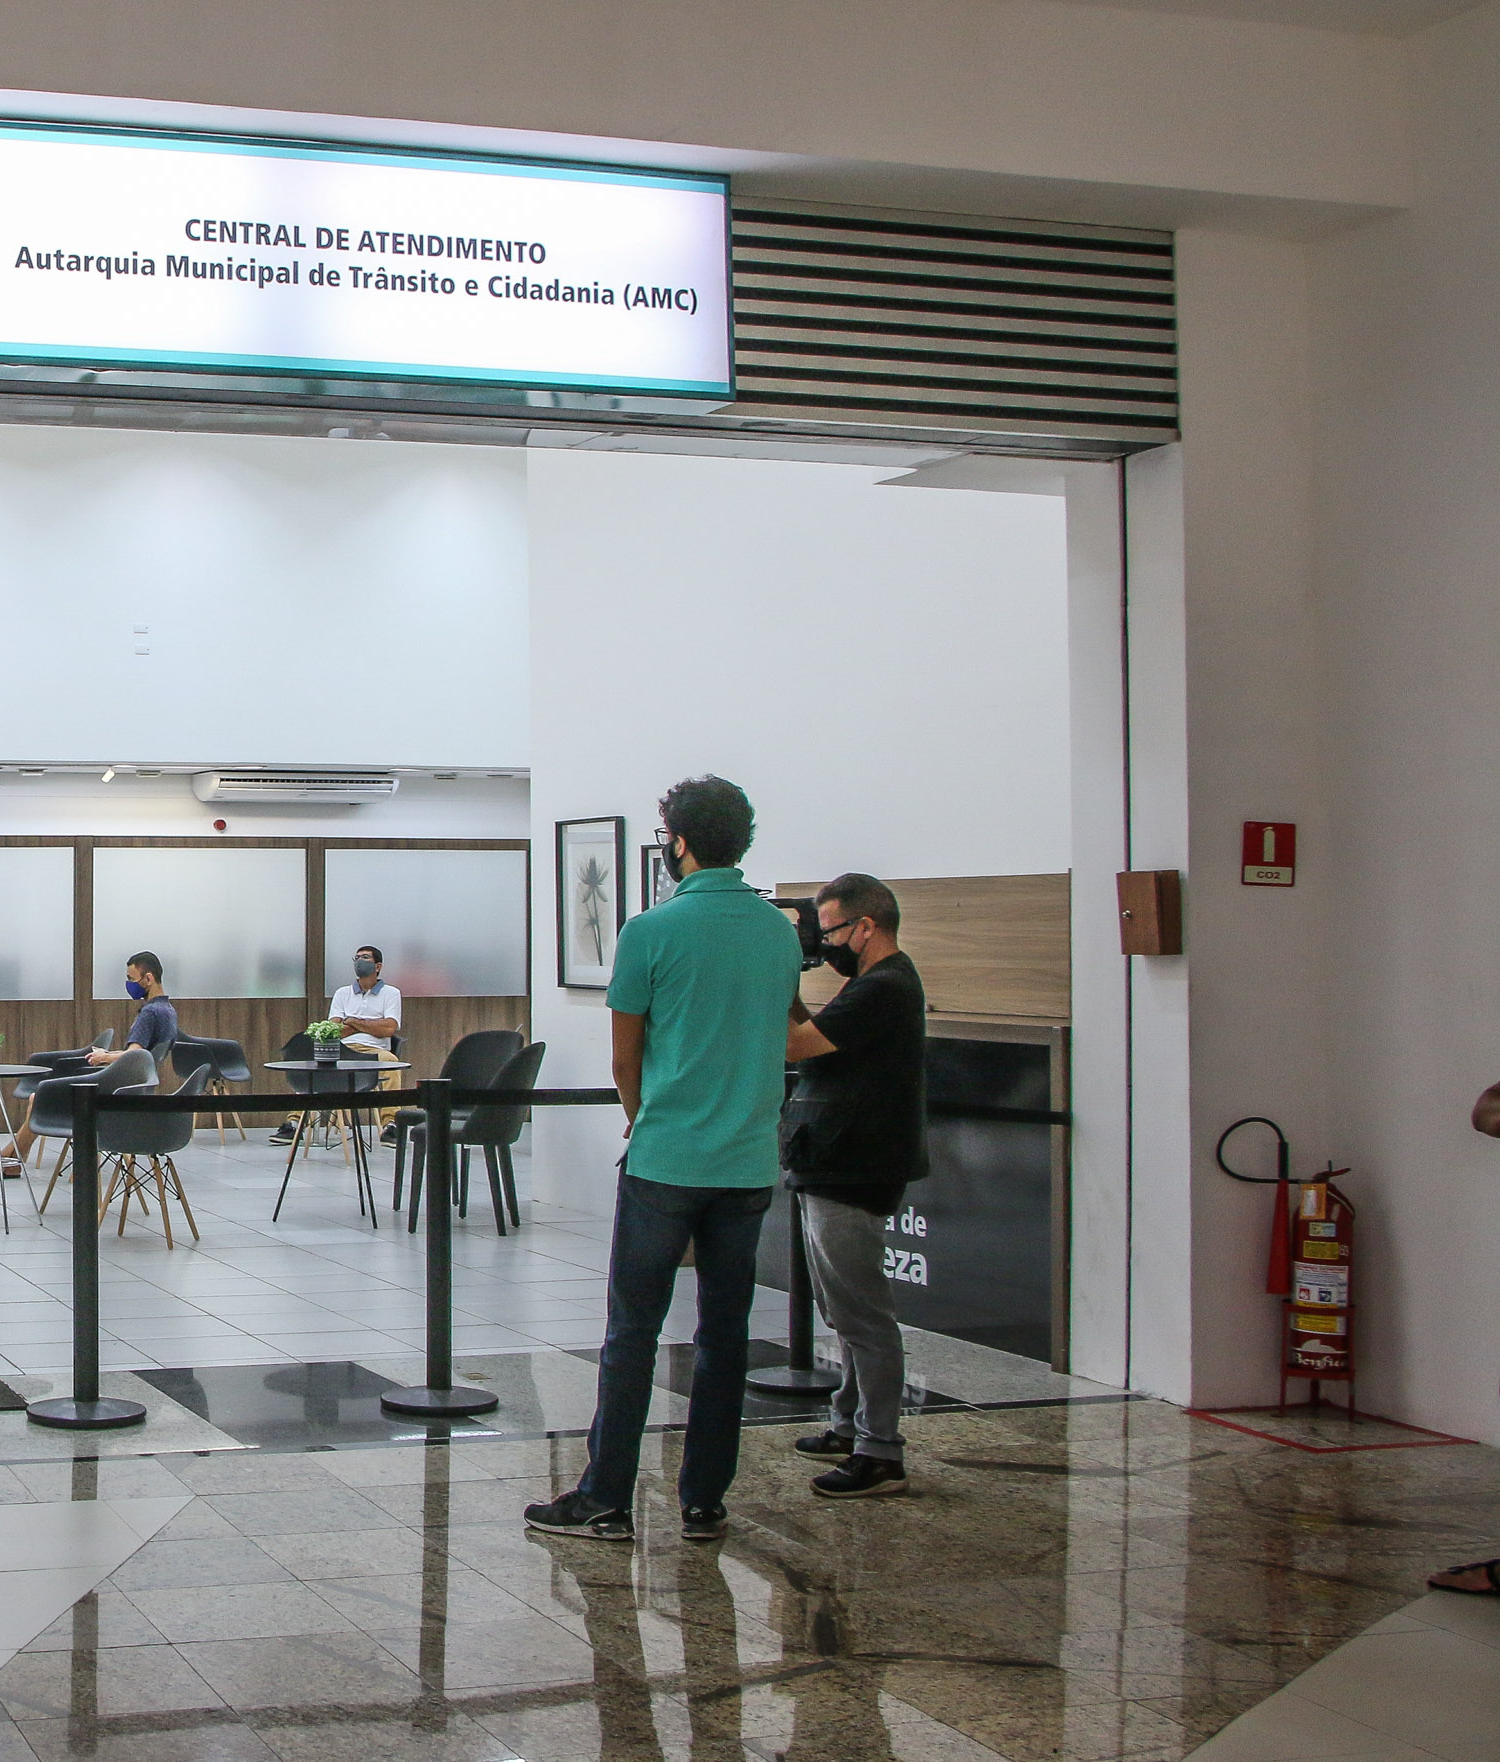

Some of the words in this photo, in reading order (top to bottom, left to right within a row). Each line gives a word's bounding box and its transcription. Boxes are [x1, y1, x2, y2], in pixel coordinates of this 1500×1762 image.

[185, 218, 307, 248] CENTRAL
[316, 226, 350, 251] DE
[357, 230, 546, 265] ATENDIMENTO
[14, 246, 156, 280] Autarquia
[166, 254, 299, 289] Municipal
[308, 262, 341, 288] de
[348, 266, 456, 295] Trânsito
[464, 279, 479, 296] e
[488, 275, 615, 306] Cidadania
[623, 283, 698, 316] (AMC)
[1257, 871, 1280, 879] CO2
[900, 1205, 927, 1237] de
[882, 1246, 928, 1286] eza
